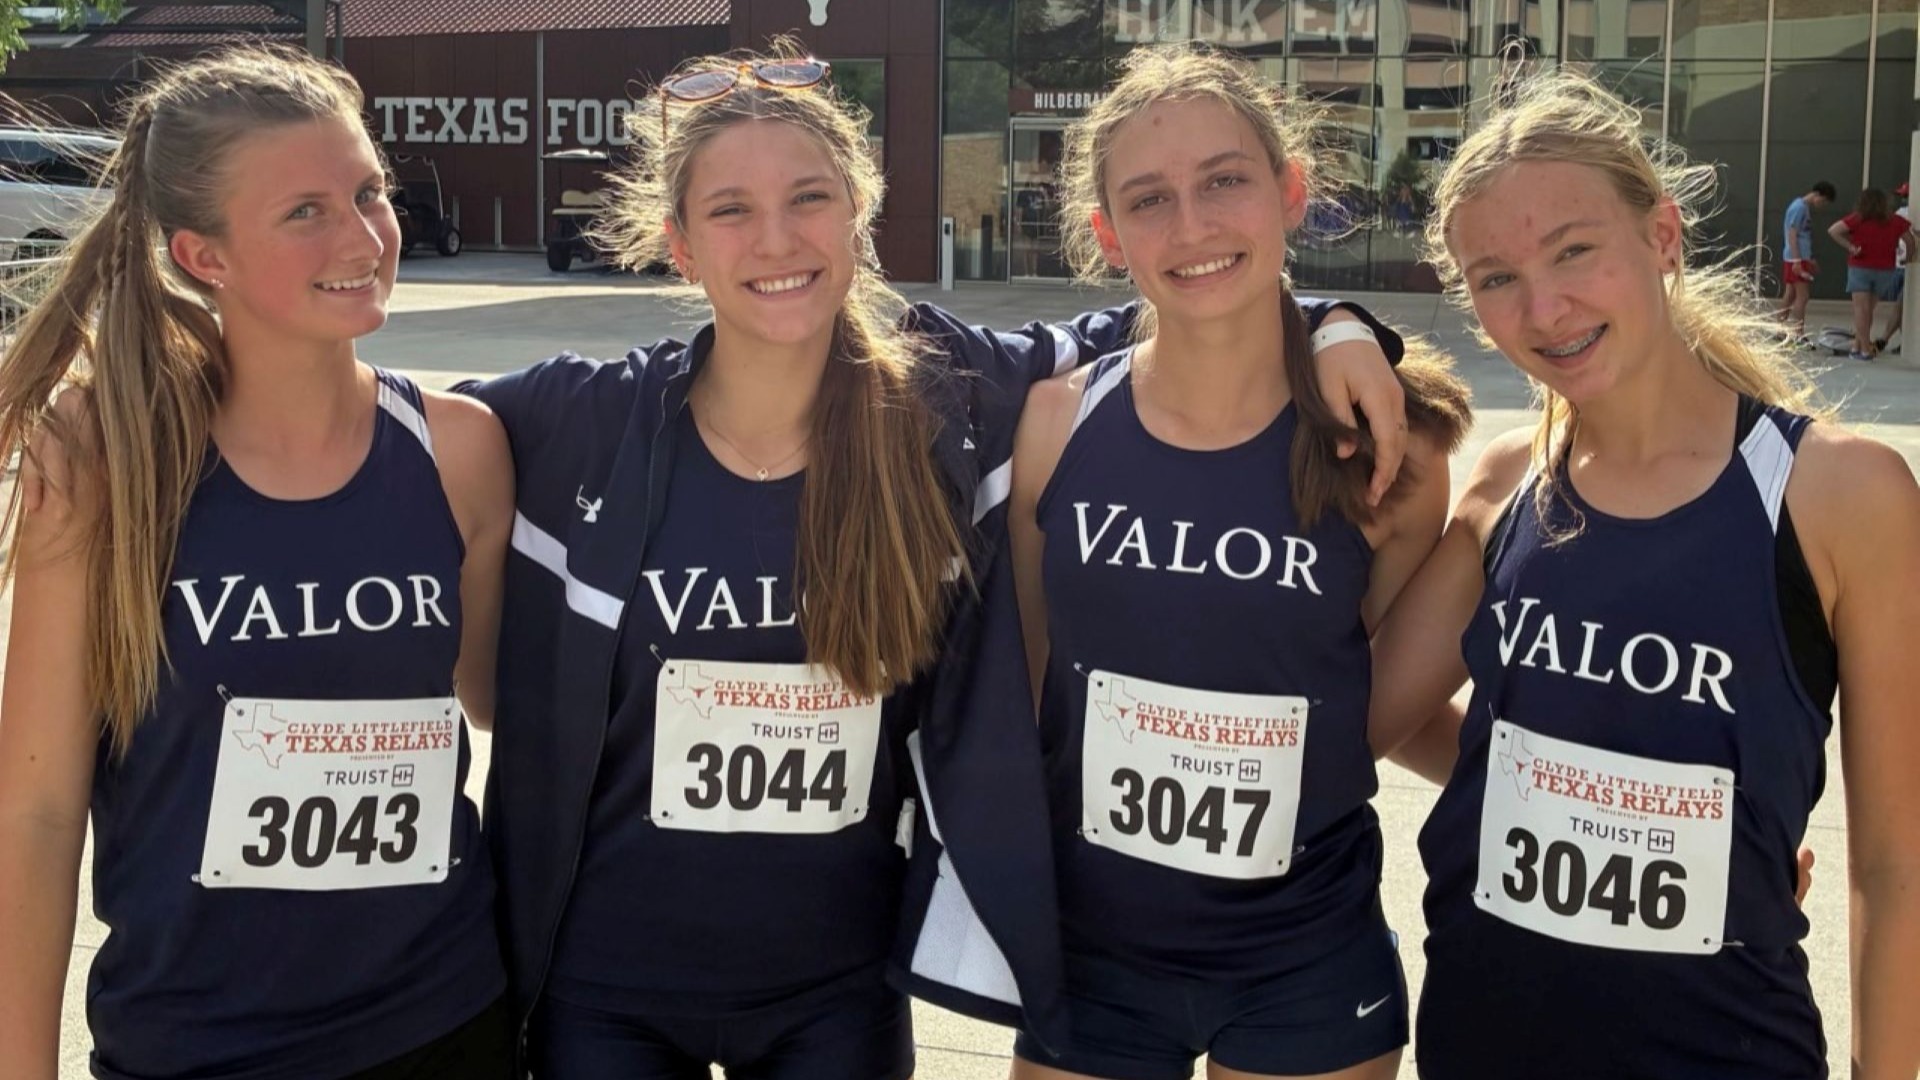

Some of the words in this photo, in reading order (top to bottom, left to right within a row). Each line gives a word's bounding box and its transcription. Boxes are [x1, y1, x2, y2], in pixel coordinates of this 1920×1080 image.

[374, 97, 529, 144] TEXAS
[547, 98, 642, 146] FOO
[1073, 502, 1323, 596] VALOR
[172, 574, 451, 646] VALOR
[642, 567, 809, 635] VAL
[1491, 597, 1736, 714] VALOR
[714, 690, 791, 710] TEXAS
[715, 680, 768, 693] CLYDE
[287, 722, 346, 734] CLYDE
[352, 720, 453, 734] LITTLEFIELD
[752, 722, 814, 739] TRUIST
[1136, 713, 1210, 742] TEXAS
[1215, 727, 1298, 747] RELAYS
[1137, 702, 1188, 721] CLYDE
[1194, 712, 1299, 729] LITTLEFIELD
[285, 735, 367, 754] TEXAS
[372, 731, 453, 752] RELAYS
[324, 769, 389, 786] TRUIST
[684, 742, 847, 813] 3044
[1170, 754, 1235, 777] TRUIST
[1533, 757, 1589, 781] CLYDE
[1596, 773, 1724, 800] LITTLEFIELD
[1109, 767, 1271, 857] 3047
[1531, 770, 1614, 806] TEXAS
[1620, 791, 1724, 819] RELAYS
[242, 792, 420, 868] 3043
[1569, 815, 1643, 844] TRUIST
[1502, 826, 1687, 930] 3046
